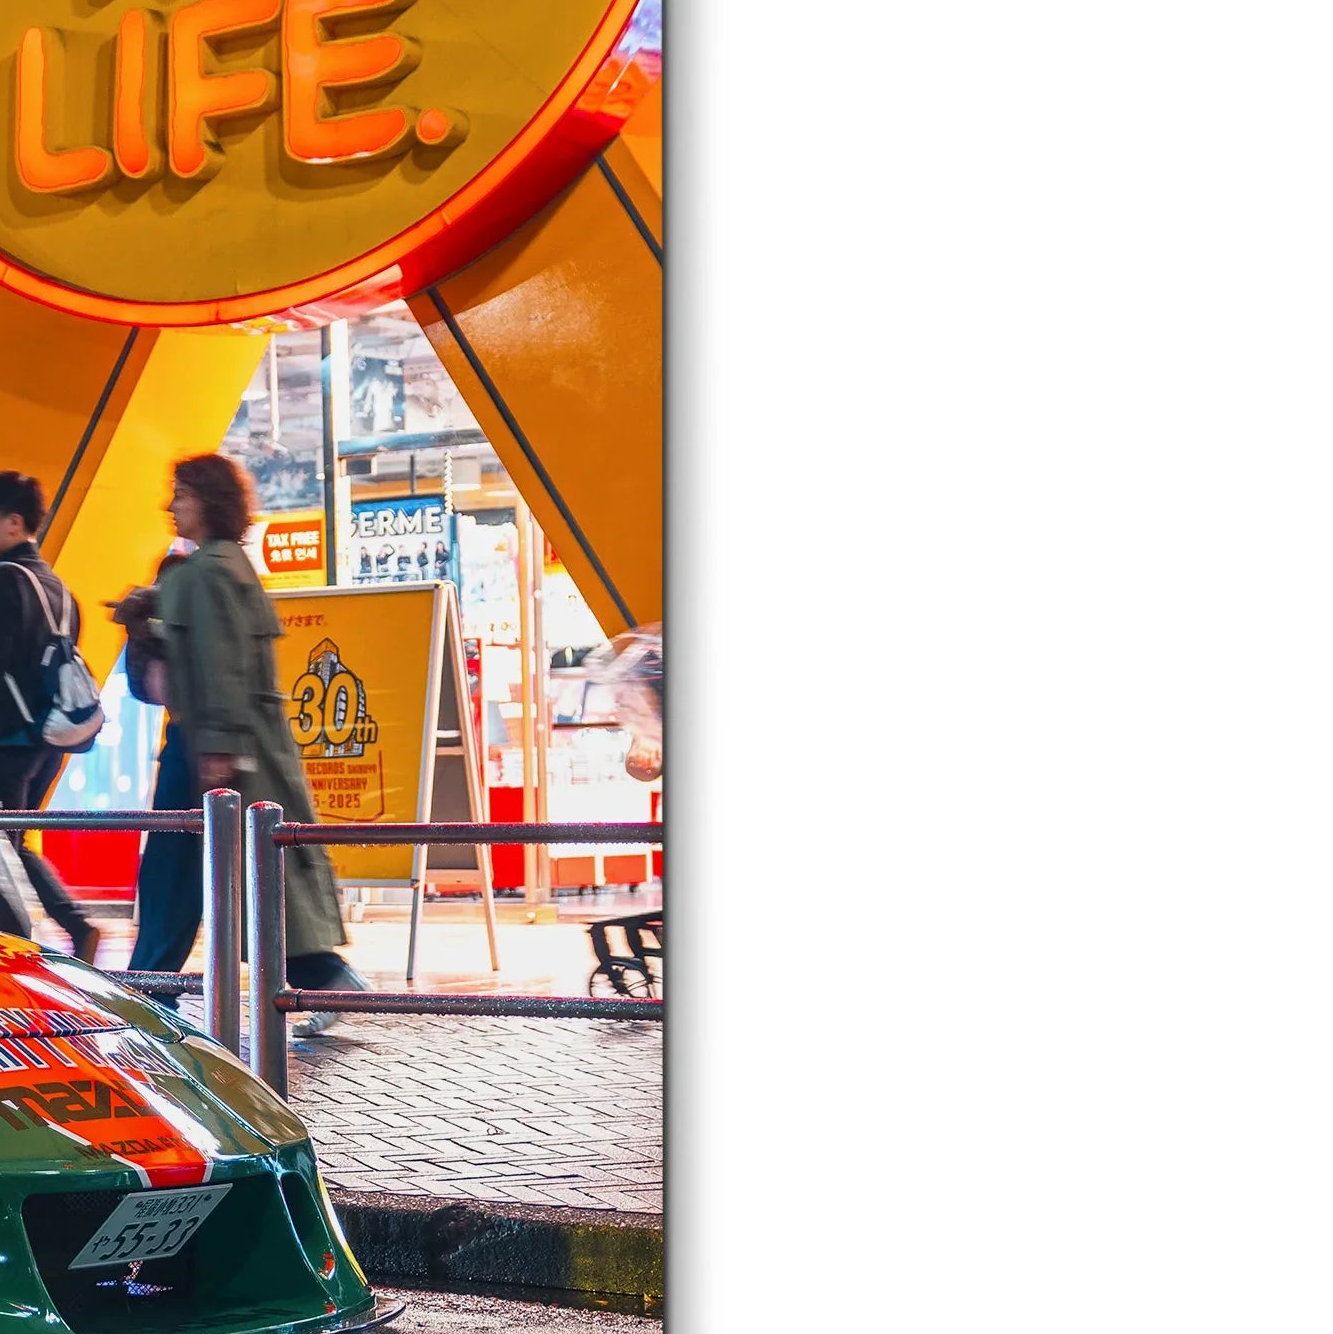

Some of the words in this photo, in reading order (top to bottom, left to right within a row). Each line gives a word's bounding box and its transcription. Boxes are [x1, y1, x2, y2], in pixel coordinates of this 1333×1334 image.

[266, 533, 289, 547] TAX
[291, 531, 320, 545] FREE
[169, 1194, 204, 1214] 331
[99, 1216, 200, 1261] 55-33
